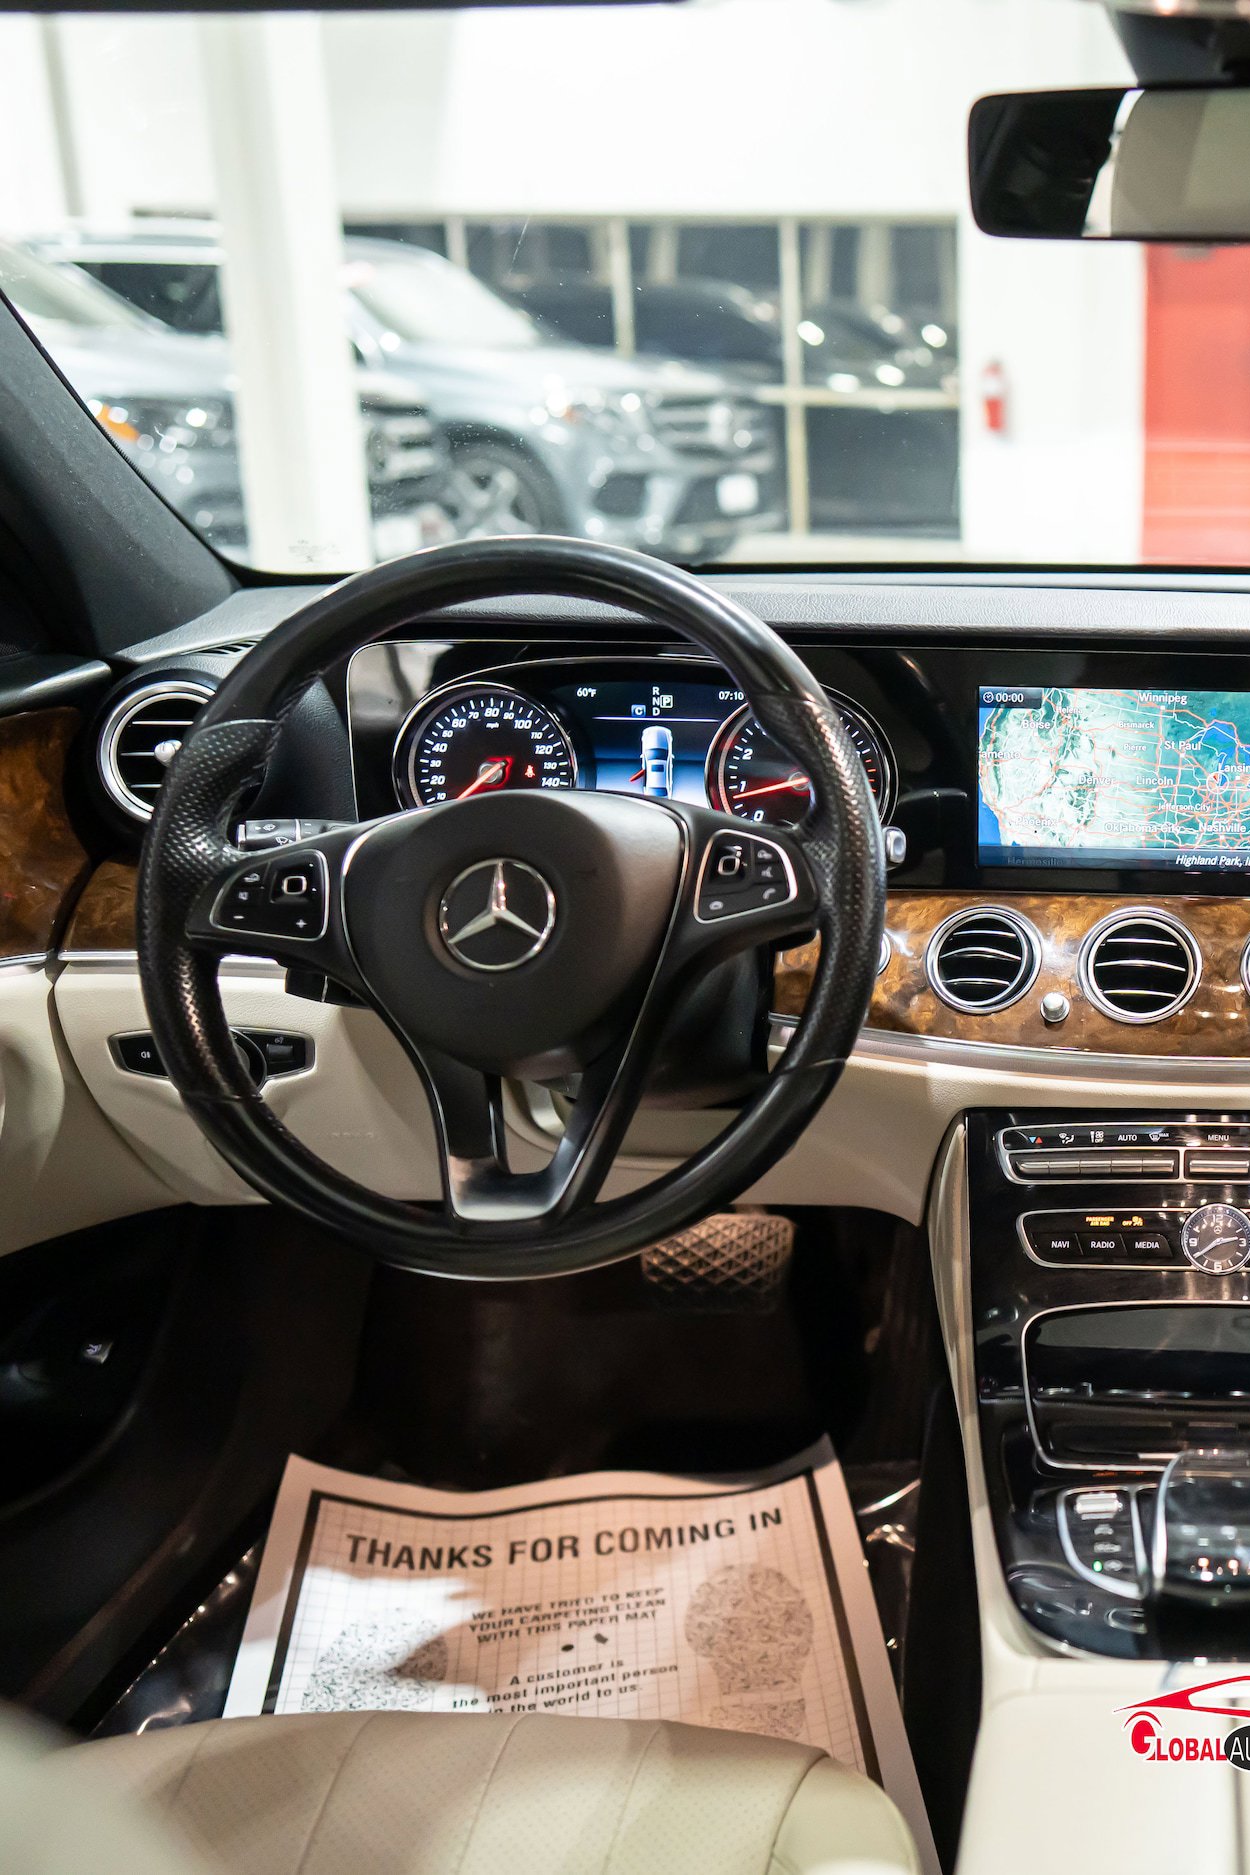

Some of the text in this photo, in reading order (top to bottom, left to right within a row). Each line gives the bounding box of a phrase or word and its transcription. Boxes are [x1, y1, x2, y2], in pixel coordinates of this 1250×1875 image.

[652, 686, 660, 695] R
[718, 691, 744, 701] 07:10
[996, 693, 1024, 702] 00:00
[1139, 692, 1187, 705] Winnipeg
[485, 708, 500, 717] 80
[503, 712, 514, 720] 90
[652, 707, 660, 716] D
[452, 719, 467, 728] 60
[514, 720, 532, 729] 100
[1022, 720, 1051, 729] Boise
[1119, 721, 1154, 729] Bismarck
[432, 743, 447, 753] 40
[535, 745, 553, 755] 120
[1164, 741, 1201, 750] St Paul
[742, 749, 753, 760] 2
[430, 760, 442, 768] 30
[544, 762, 557, 770] 130
[430, 775, 446, 785] 20
[541, 778, 560, 787] 140
[1079, 776, 1114, 785] Denver
[1136, 776, 1174, 785] Lincoln
[739, 781, 746, 792] 1
[437, 793, 446, 801] 10
[1158, 803, 1211, 812] Jefferson City
[753, 810, 765, 822] 0
[1015, 817, 1056, 826] Phoenix
[1105, 823, 1181, 834] Oklahoma City
[1198, 824, 1246, 833] Nashville
[1176, 855, 1217, 867] Highland
[1219, 856, 1243, 867] Park,
[1207, 1134, 1230, 1142] MENU
[1212, 1214, 1224, 1222] 12
[1051, 1241, 1070, 1249] NAVI
[1090, 1241, 1116, 1249] RADIO
[1135, 1241, 1160, 1249] MEDIA
[1188, 1238, 1198, 1247] 9
[1239, 1238, 1247, 1247] 3
[1213, 1262, 1222, 1271] 6
[346, 1508, 782, 1570] THANKS FOR COMING IN
[472, 1587, 664, 1621] WE HAVE TRIED TO KEEP
[469, 1599, 665, 1632] YOUR CARPETING CLEAN
[477, 1610, 656, 1643] WITH THIS PAPER MAT
[510, 1658, 624, 1686] A customer is
[452, 1664, 679, 1709] the most important person
[510, 1701, 537, 1712] the
[543, 1690, 590, 1708] world
[597, 1688, 612, 1698] to
